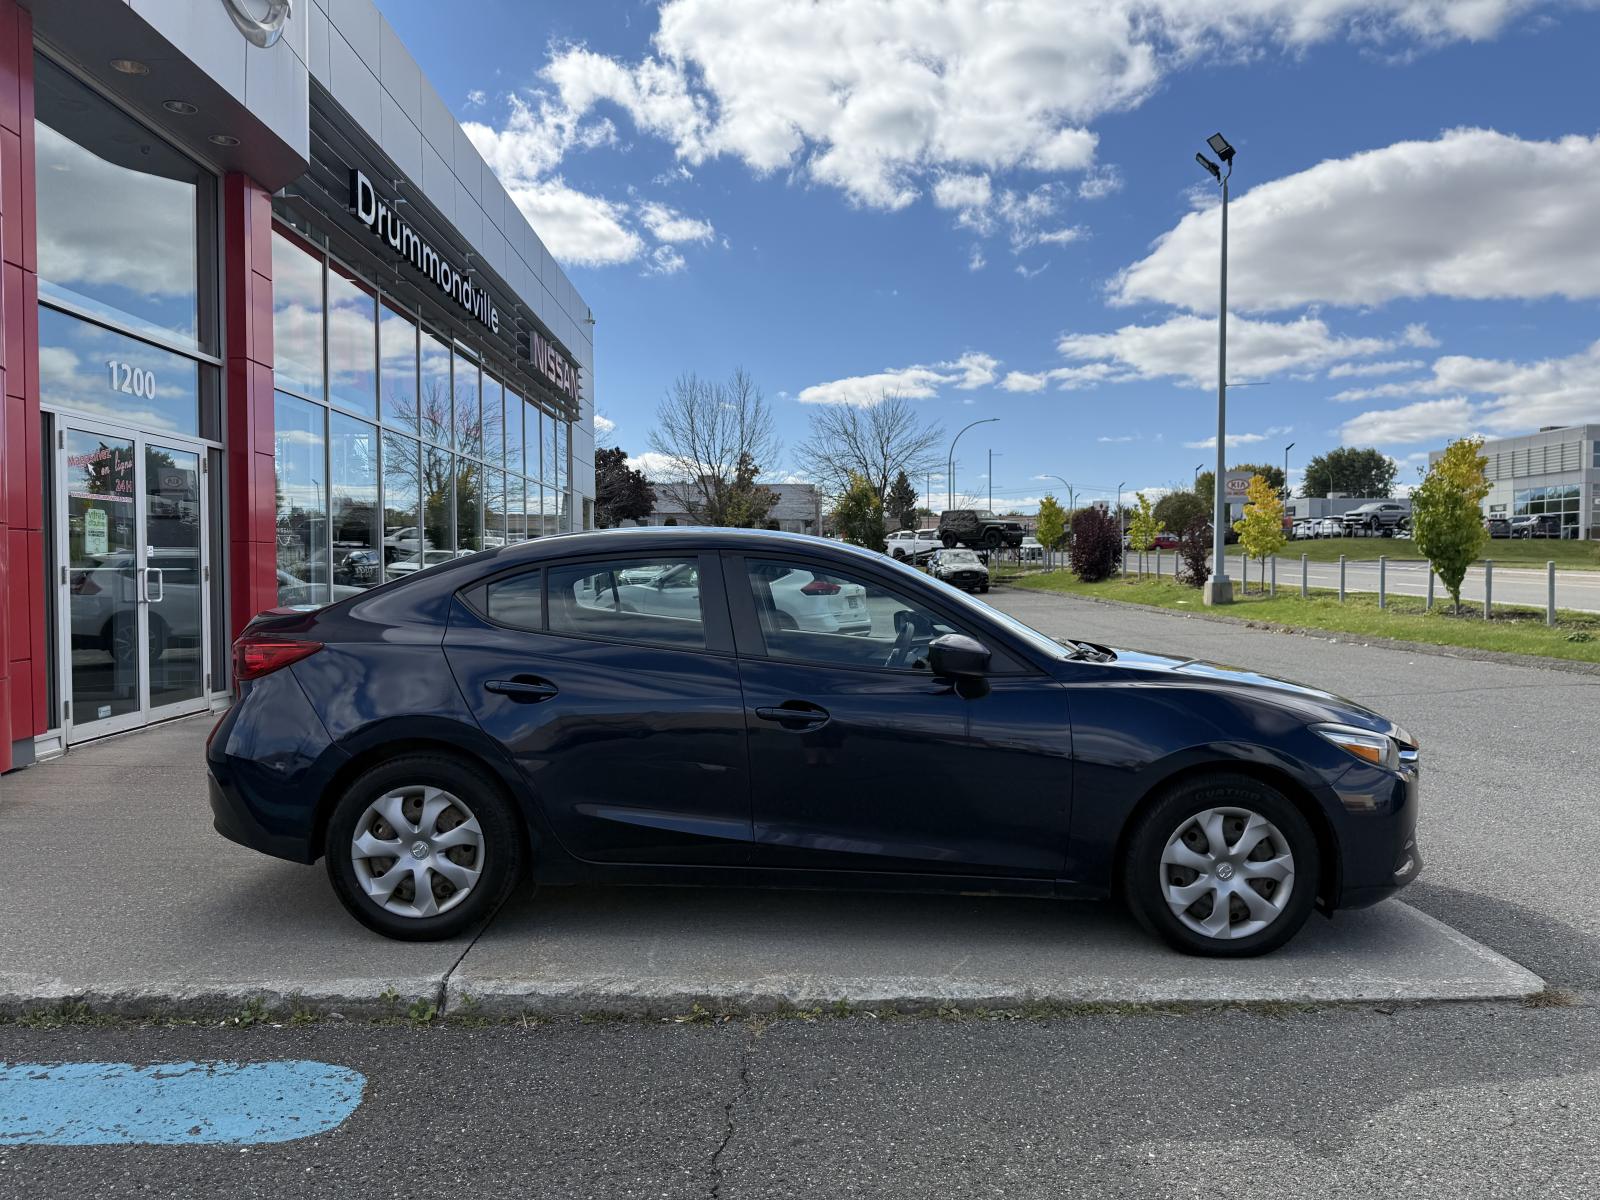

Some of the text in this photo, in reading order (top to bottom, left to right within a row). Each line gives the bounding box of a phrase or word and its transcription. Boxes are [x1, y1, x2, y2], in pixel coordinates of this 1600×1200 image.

[356, 169, 579, 402] Drummondville NISSAN
[109, 360, 156, 400] 1200
